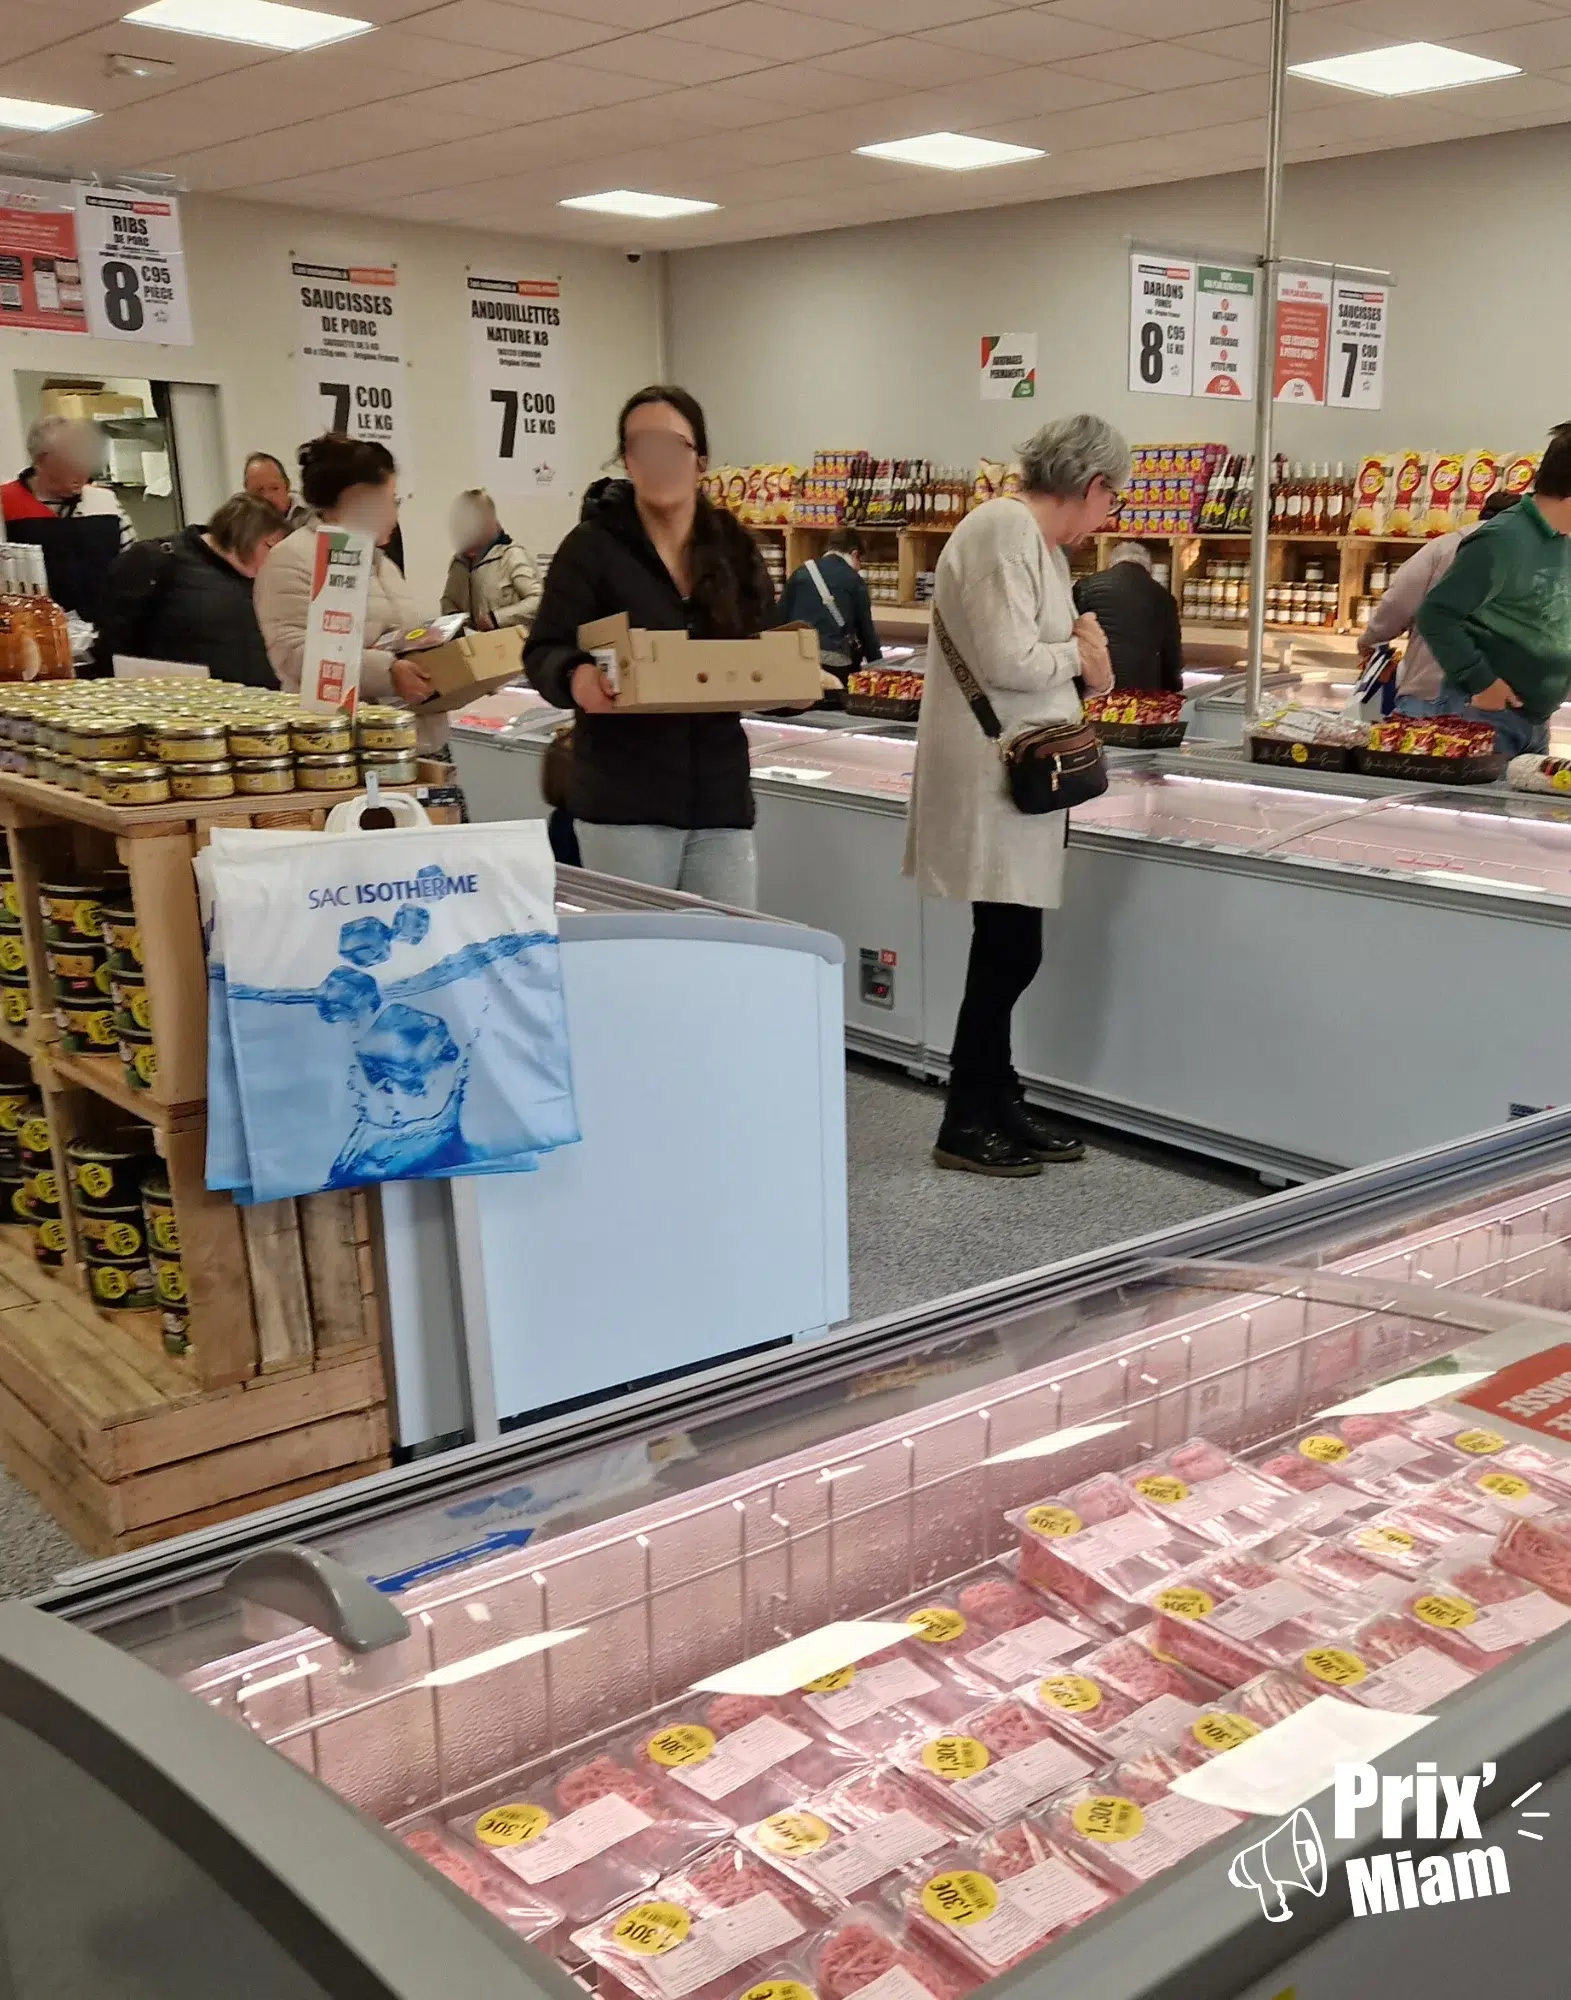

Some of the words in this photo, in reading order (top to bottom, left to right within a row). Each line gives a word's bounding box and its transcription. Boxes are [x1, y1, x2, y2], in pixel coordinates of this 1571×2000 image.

[112, 215, 148, 235] RIBS
[102, 261, 144, 331] 8
[301, 287, 393, 316] SAUCISSES
[472, 300, 560, 326] ANDOUILLETTES
[1338, 303, 1382, 321] SAUCISSES
[321, 316, 339, 333] DE
[341, 318, 377, 337] PORC
[487, 326, 531, 344] NATURE
[1140, 322, 1163, 384] 8
[1341, 342, 1359, 398] 7
[319, 382, 350, 435] 7
[358, 413, 371, 429] LE
[374, 414, 393, 430] KG
[490, 389, 518, 458] 7
[524, 418, 536, 433] LE
[539, 419, 555, 435] KG
[308, 886, 350, 909] SAC
[356, 874, 479, 904] ISOTHERME
[1421, 1602, 1464, 1626] 1,30€
[1307, 1656, 1350, 1683] 1,30€
[656, 1736, 697, 1762] 1,30€
[936, 1741, 960, 1773] 1,30€
[478, 1817, 536, 1841] 1,30€
[1086, 1799, 1116, 1835] 1,30€
[930, 1879, 973, 1922] 1,30€
